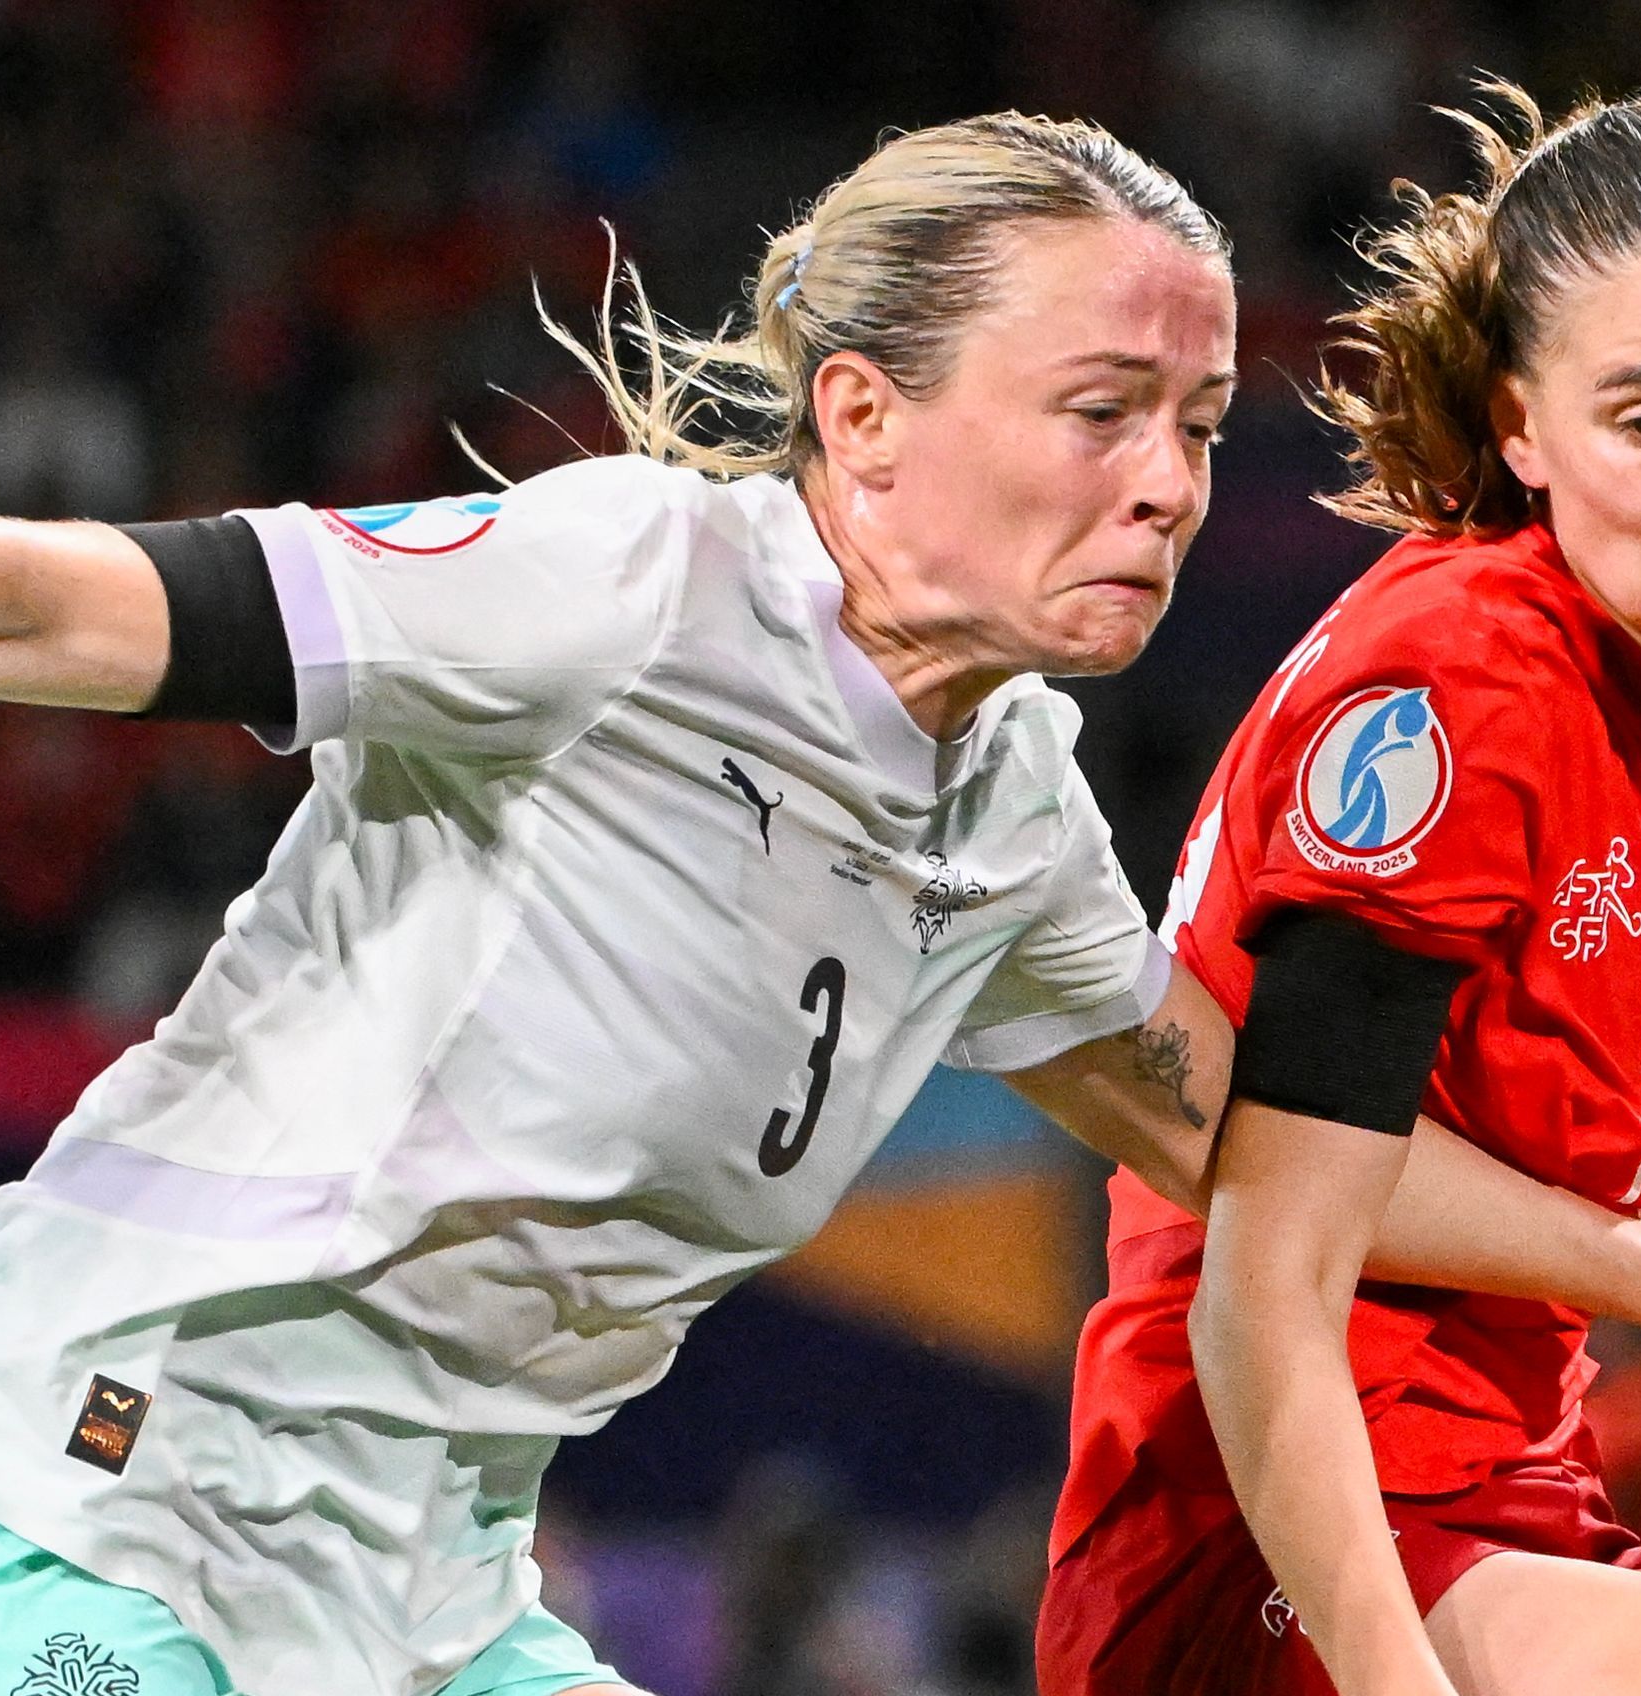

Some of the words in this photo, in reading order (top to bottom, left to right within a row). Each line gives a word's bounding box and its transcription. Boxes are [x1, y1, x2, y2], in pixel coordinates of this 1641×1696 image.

[1290, 812, 1367, 873] SWITZERLAND
[1371, 850, 1409, 873] 2025
[757, 956, 847, 1178] 3
